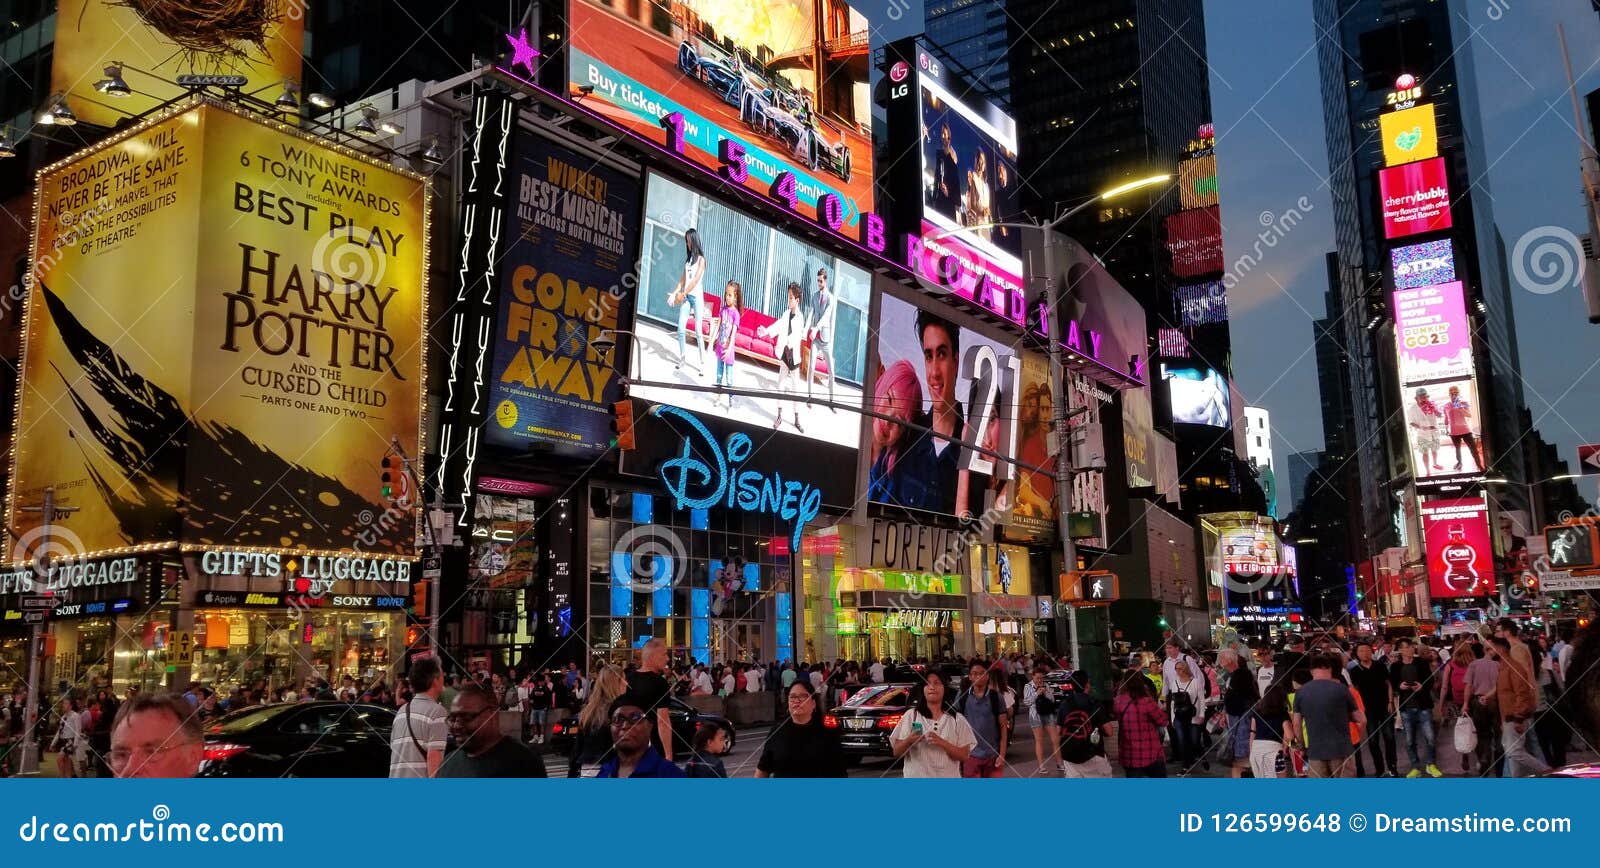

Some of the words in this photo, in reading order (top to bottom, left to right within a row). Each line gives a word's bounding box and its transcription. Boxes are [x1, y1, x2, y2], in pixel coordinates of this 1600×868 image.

[182, 76, 239, 84] LAMAR
[588, 64, 618, 96] Buy
[928, 59, 938, 77] LG
[891, 84, 908, 99] LG
[48, 189, 88, 220] NEVER
[94, 179, 109, 200] BE
[114, 165, 140, 192] THE
[146, 146, 188, 178] SAME.
[58, 152, 135, 193] "BROADWA
[282, 143, 367, 187] WINNER!
[548, 156, 608, 204] WINNER!
[115, 187, 150, 208] MARVEL
[154, 172, 178, 191] THAT
[240, 151, 250, 167] 6
[257, 155, 316, 188] TONY
[322, 179, 400, 216] AWARDS
[97, 214, 114, 232] THE
[116, 192, 176, 225] POSSIBILITIES
[234, 182, 318, 231] BEST
[330, 212, 404, 256] PLAY
[306, 192, 342, 212] including
[520, 174, 560, 214] BEST
[562, 191, 624, 241] MUSICAL
[518, 204, 532, 222] ALL
[534, 210, 566, 234] ACROSS
[568, 222, 592, 244] NORTH
[593, 230, 624, 256] AMERICA
[81, 242, 92, 255] OF
[1410, 258, 1452, 273] TDK
[237, 243, 399, 332] HARRY
[512, 264, 620, 329] COME
[220, 292, 406, 380] POTTER
[242, 366, 321, 396] CURSED
[327, 382, 387, 408] CHILD
[290, 362, 316, 376] AND
[319, 367, 342, 380] THE
[501, 345, 615, 404] AWAY
[262, 395, 292, 408] PARTS
[294, 400, 316, 412] ONE
[318, 405, 340, 416] AND
[343, 408, 366, 419] TWO
[962, 345, 1021, 480] 21
[870, 518, 965, 575] FOREVER
[0, 570, 32, 594] FTS
[47, 558, 136, 590] LUGGAGE
[202, 552, 280, 576] GIFTS
[302, 556, 410, 582] LUGGAGE
[214, 595, 236, 604] Apple
[245, 594, 278, 604] Nikon
[333, 596, 372, 606] SONY
[310, 580, 335, 592] NY
[56, 605, 81, 616] SONY
[941, 610, 950, 628] 21
[180, 632, 189, 660] ATM
